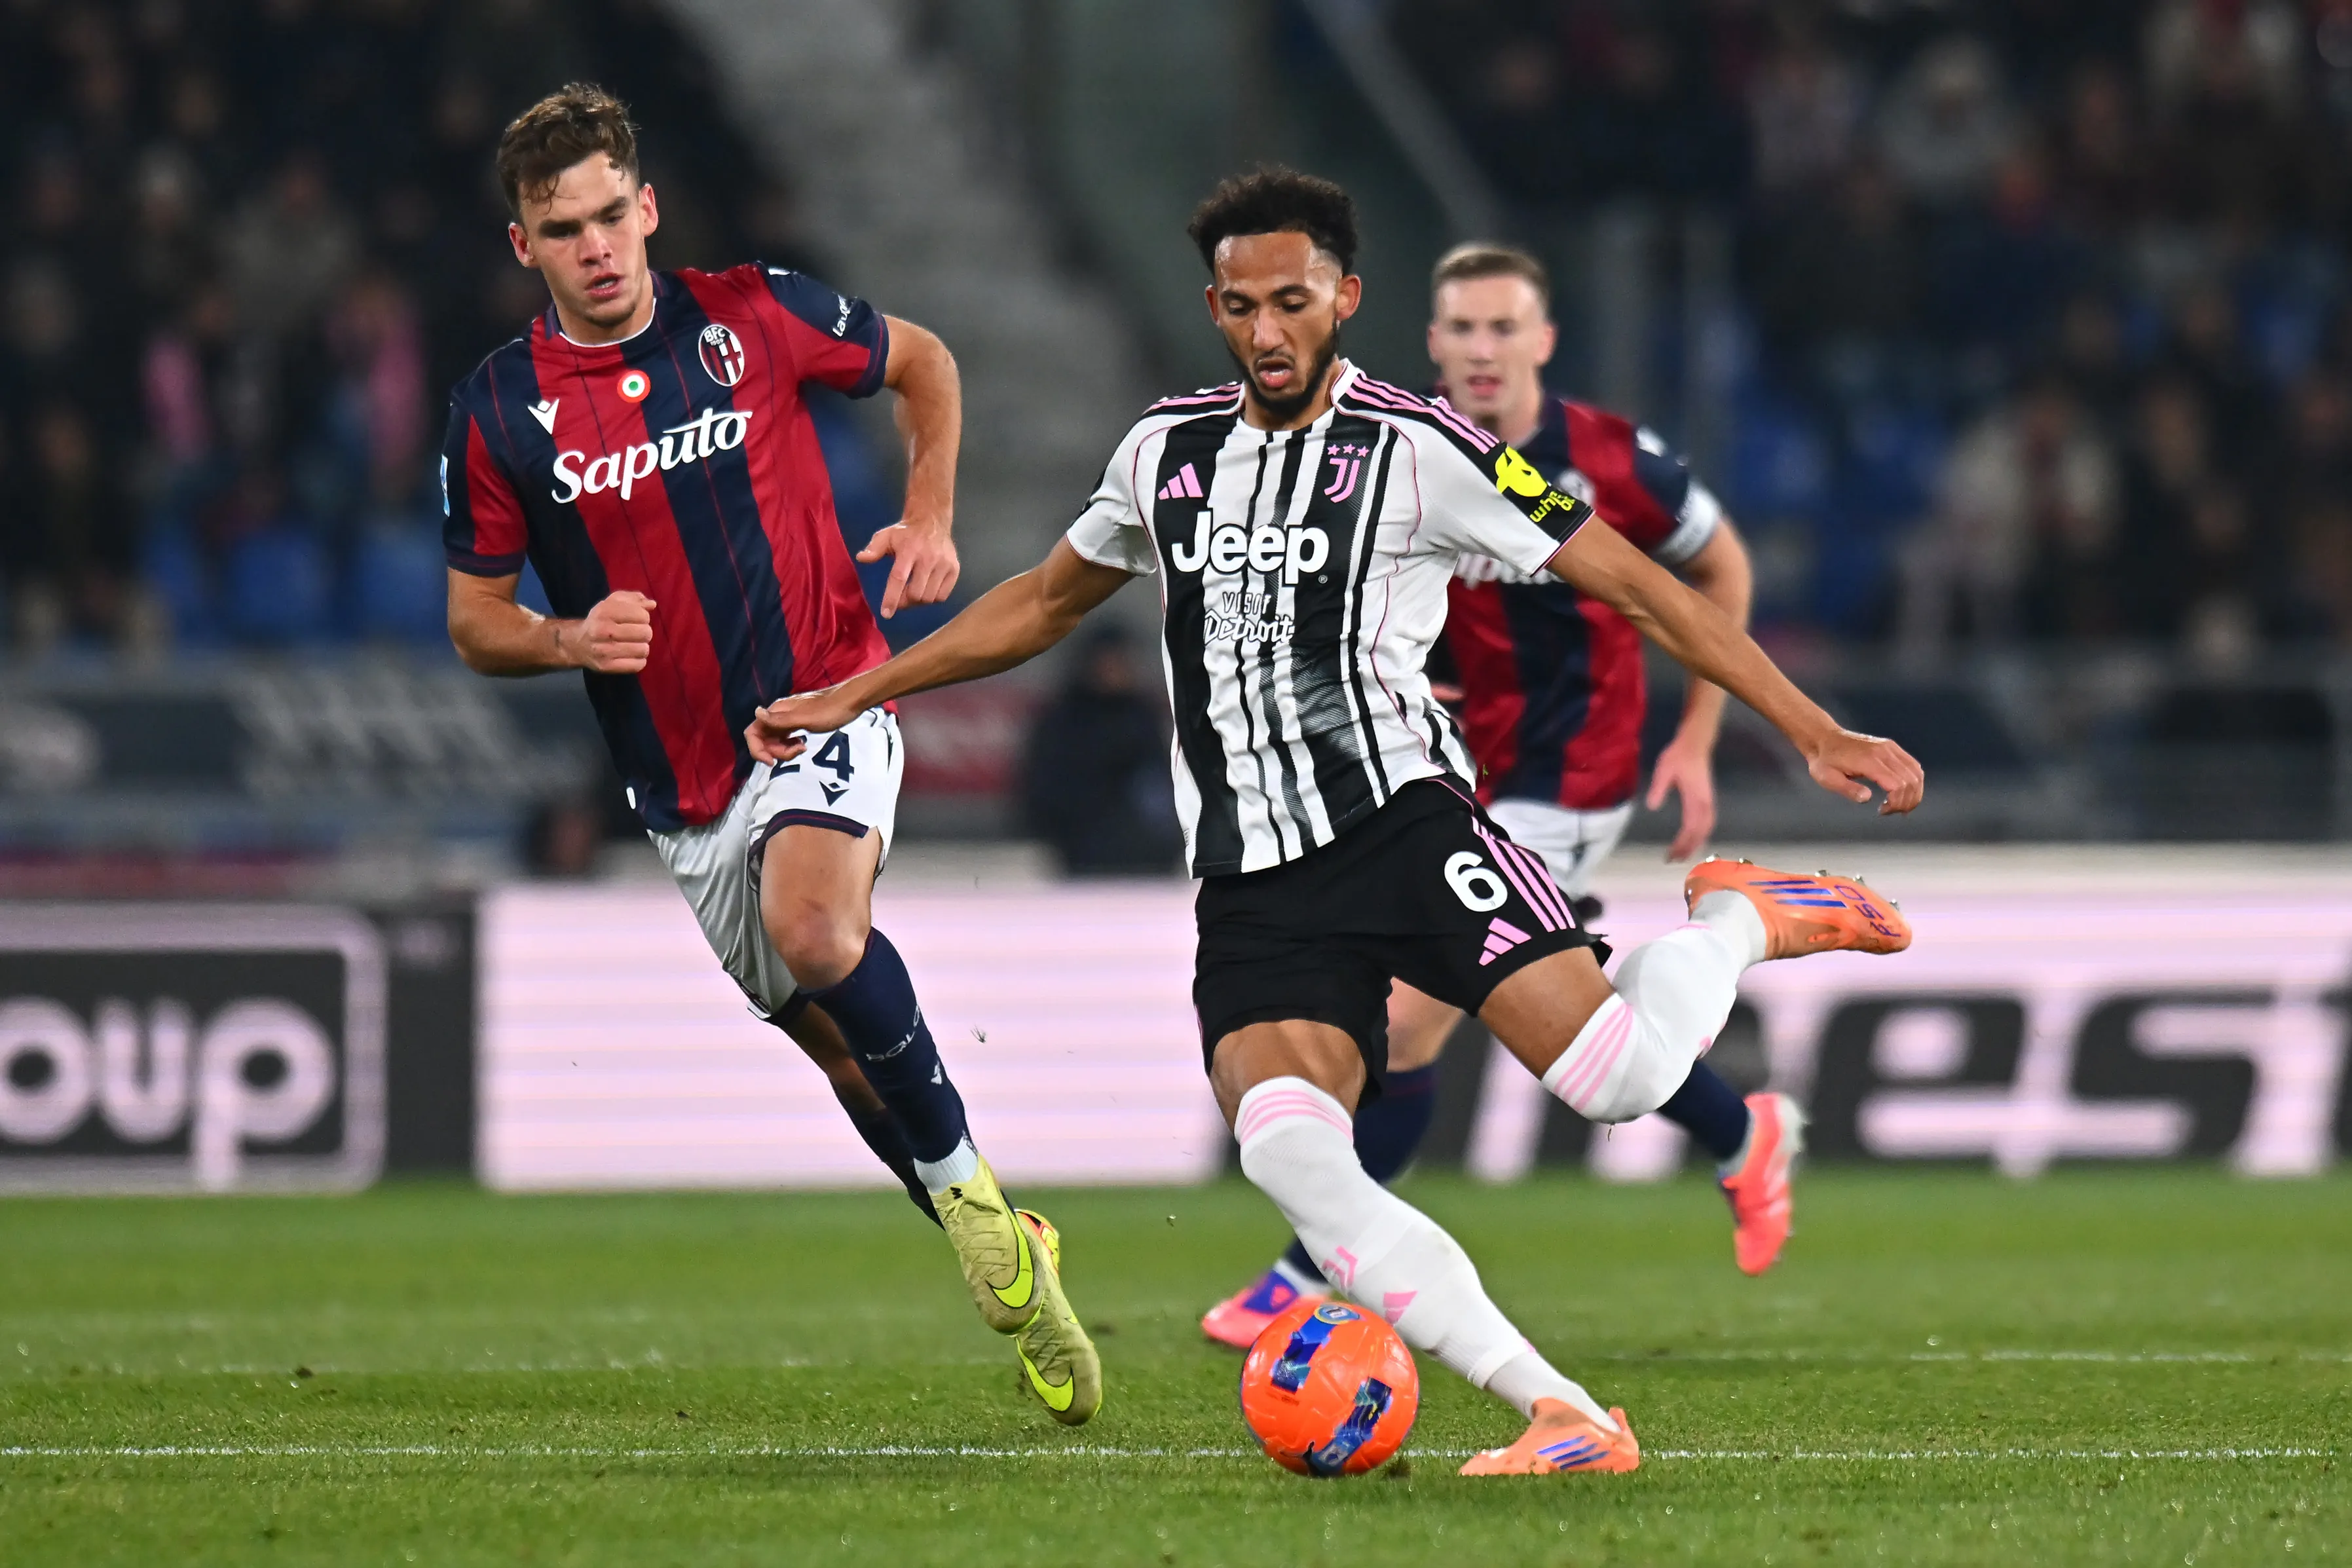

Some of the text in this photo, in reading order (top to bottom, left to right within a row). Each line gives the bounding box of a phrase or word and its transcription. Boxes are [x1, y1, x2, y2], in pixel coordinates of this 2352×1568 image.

[703, 326, 726, 343] BFC
[710, 337, 724, 346] 1909
[551, 407, 753, 504] Saputo
[1171, 510, 1330, 584] Jeep
[1222, 591, 1272, 615] VISIT
[1204, 608, 1296, 646] Detroit
[1444, 850, 1508, 912] 6
